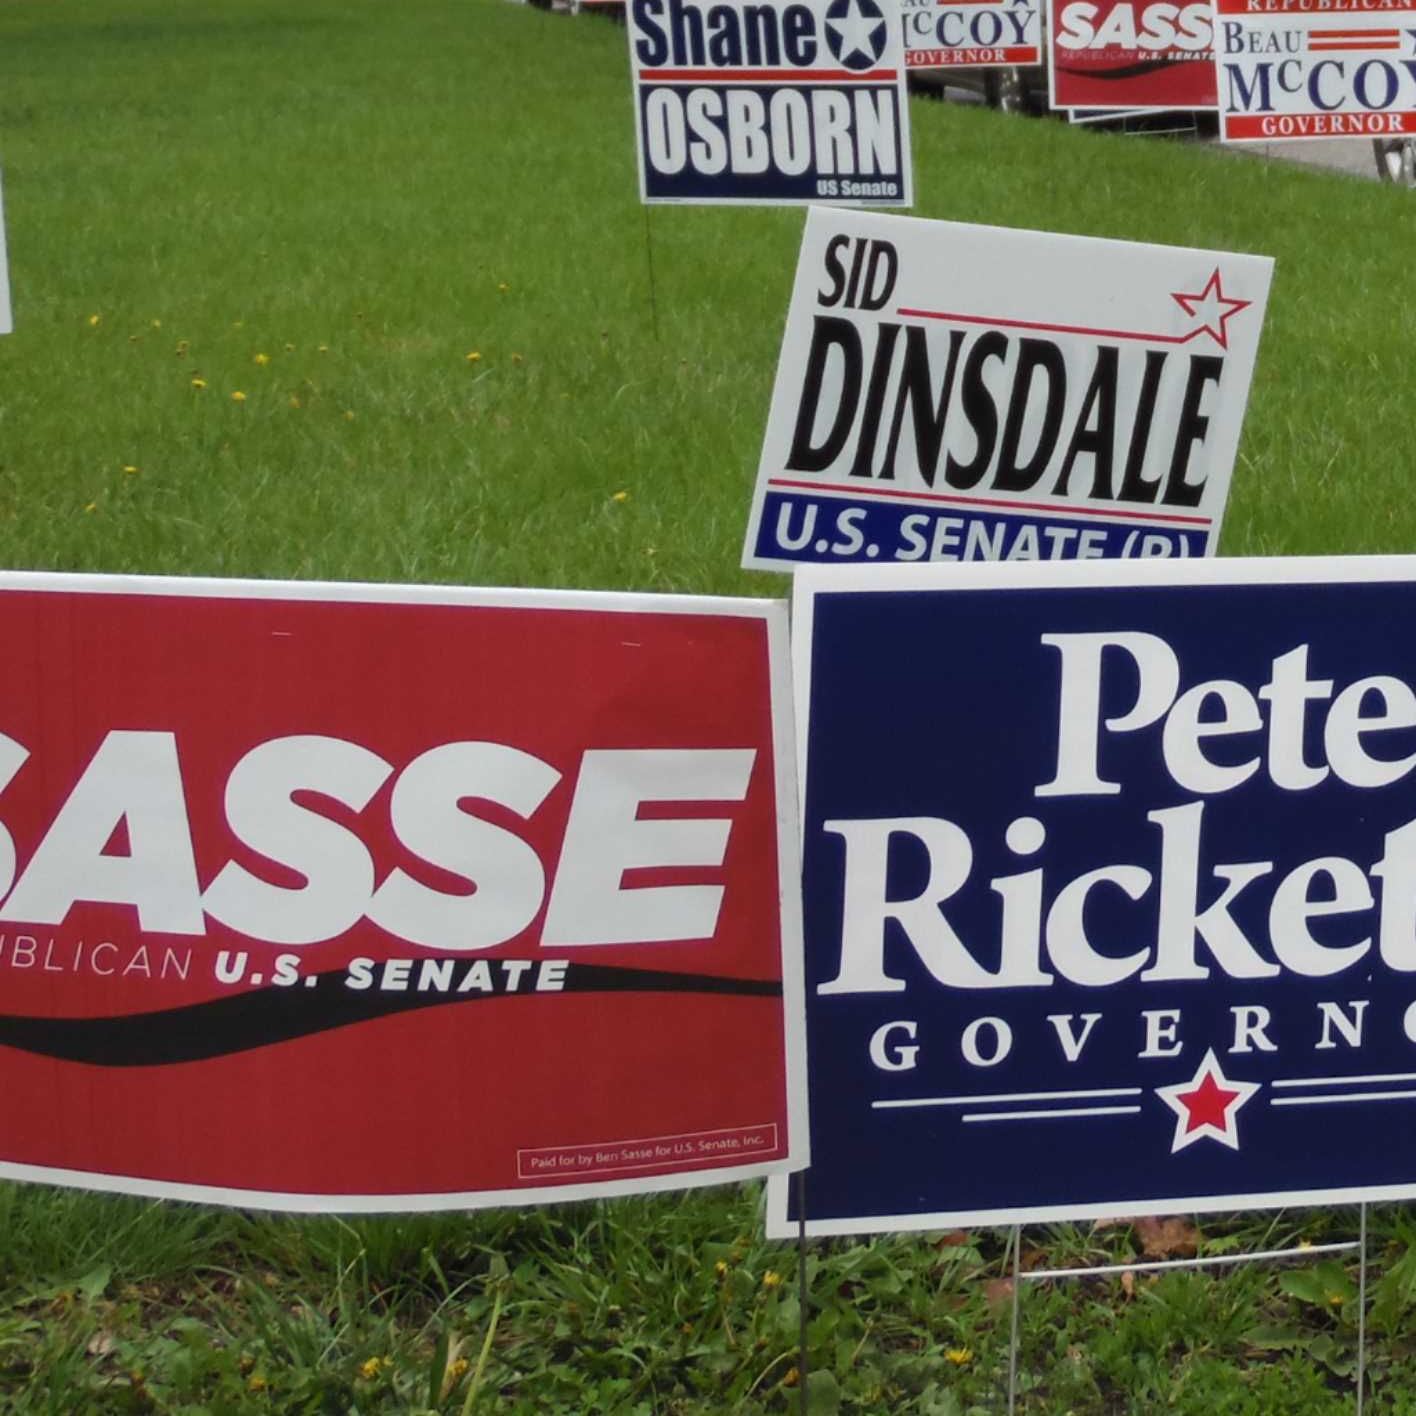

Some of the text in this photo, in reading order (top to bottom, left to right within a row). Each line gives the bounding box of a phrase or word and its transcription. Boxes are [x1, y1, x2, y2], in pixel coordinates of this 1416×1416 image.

[1056, 2, 1215, 50] SASS
[646, 87, 898, 176] OSBORN
[1261, 113, 1404, 135] GOVERNOR
[817, 179, 898, 197] US Senate
[817, 233, 899, 312] SID
[784, 314, 1225, 508] DINSDALE
[776, 501, 879, 558] U.S.
[895, 513, 1108, 563] SENATE
[0, 730, 757, 951] ASSE
[0, 935, 570, 994] BLICAN U.S. SENATE
[531, 1156, 557, 1170] Paid
[559, 1155, 577, 1167] for
[578, 1154, 594, 1169] by
[595, 1150, 619, 1164] Ben
[621, 1148, 653, 1161] Sasse
[655, 1145, 673, 1157] for
